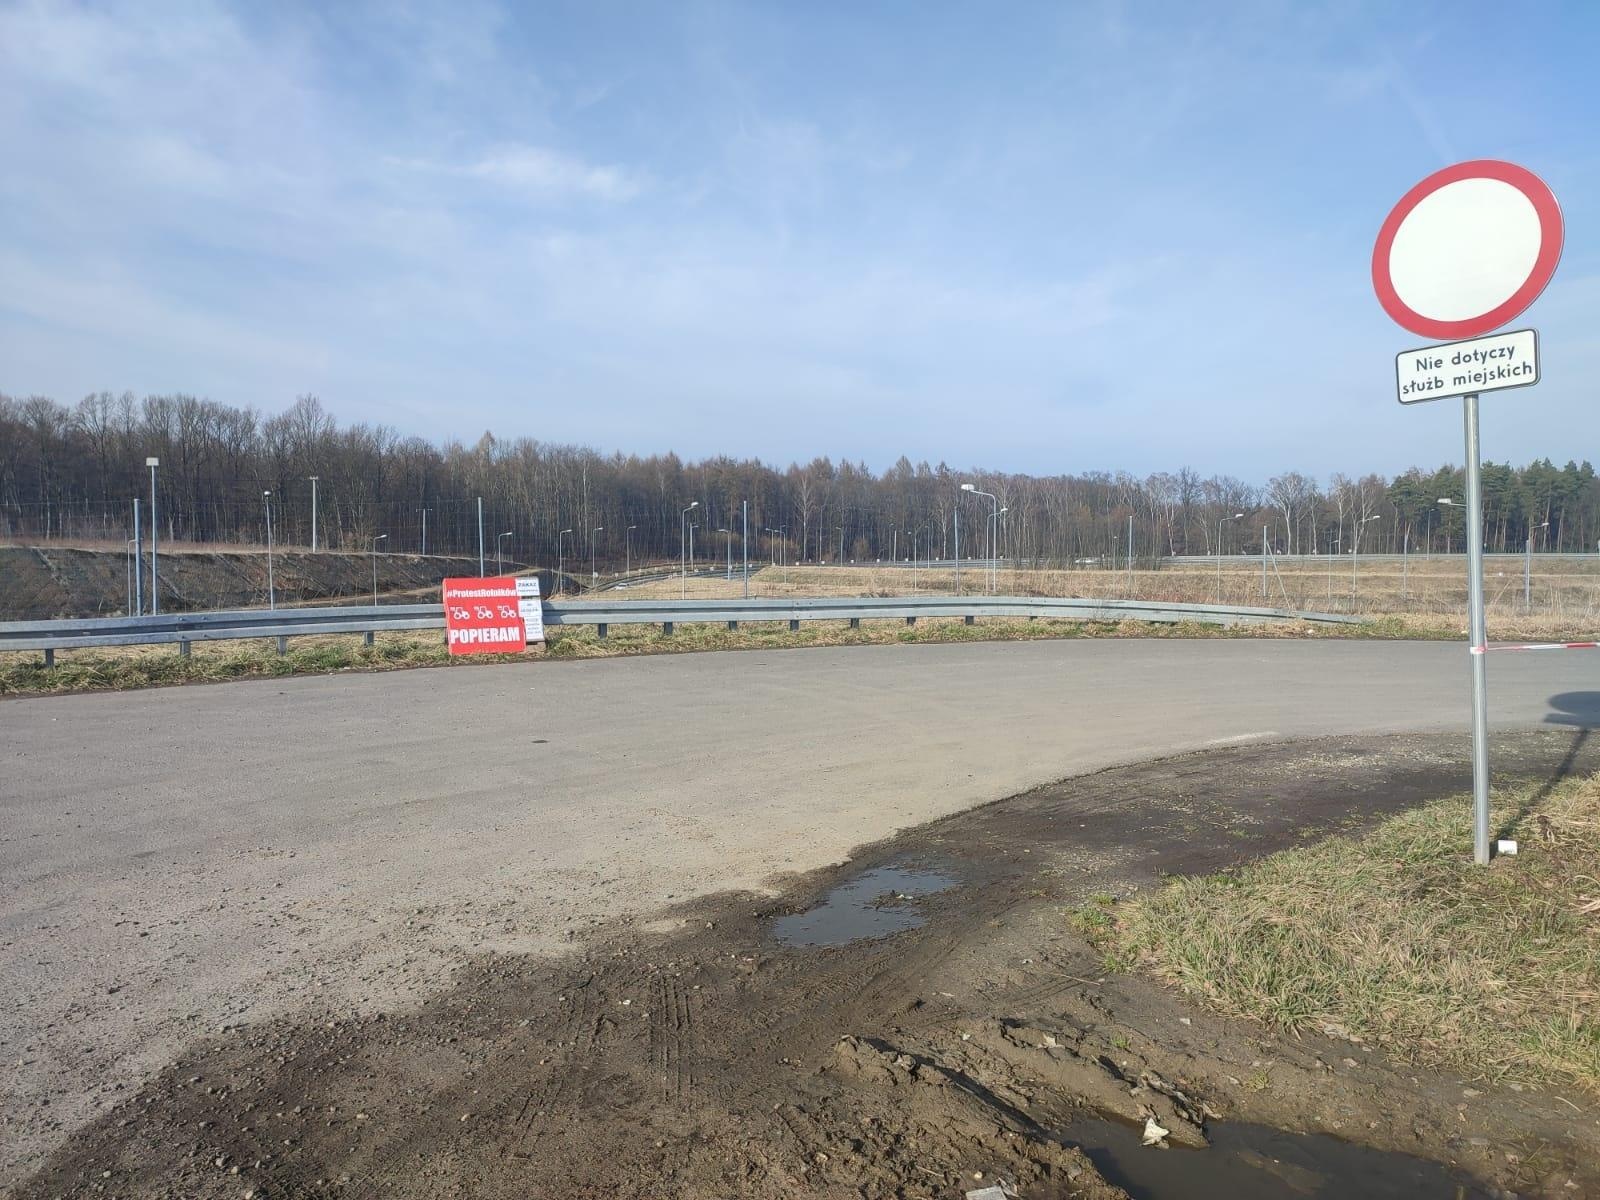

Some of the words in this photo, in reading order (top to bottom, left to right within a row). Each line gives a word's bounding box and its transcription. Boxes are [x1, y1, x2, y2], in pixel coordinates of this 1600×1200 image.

[1416, 356, 1443, 371] Nie
[1451, 346, 1515, 366] dotyczy
[1402, 377, 1444, 394] służb
[1453, 361, 1532, 386] miejskich
[447, 589, 517, 598] #ProtestRolników
[450, 627, 520, 644] POPIERAM
